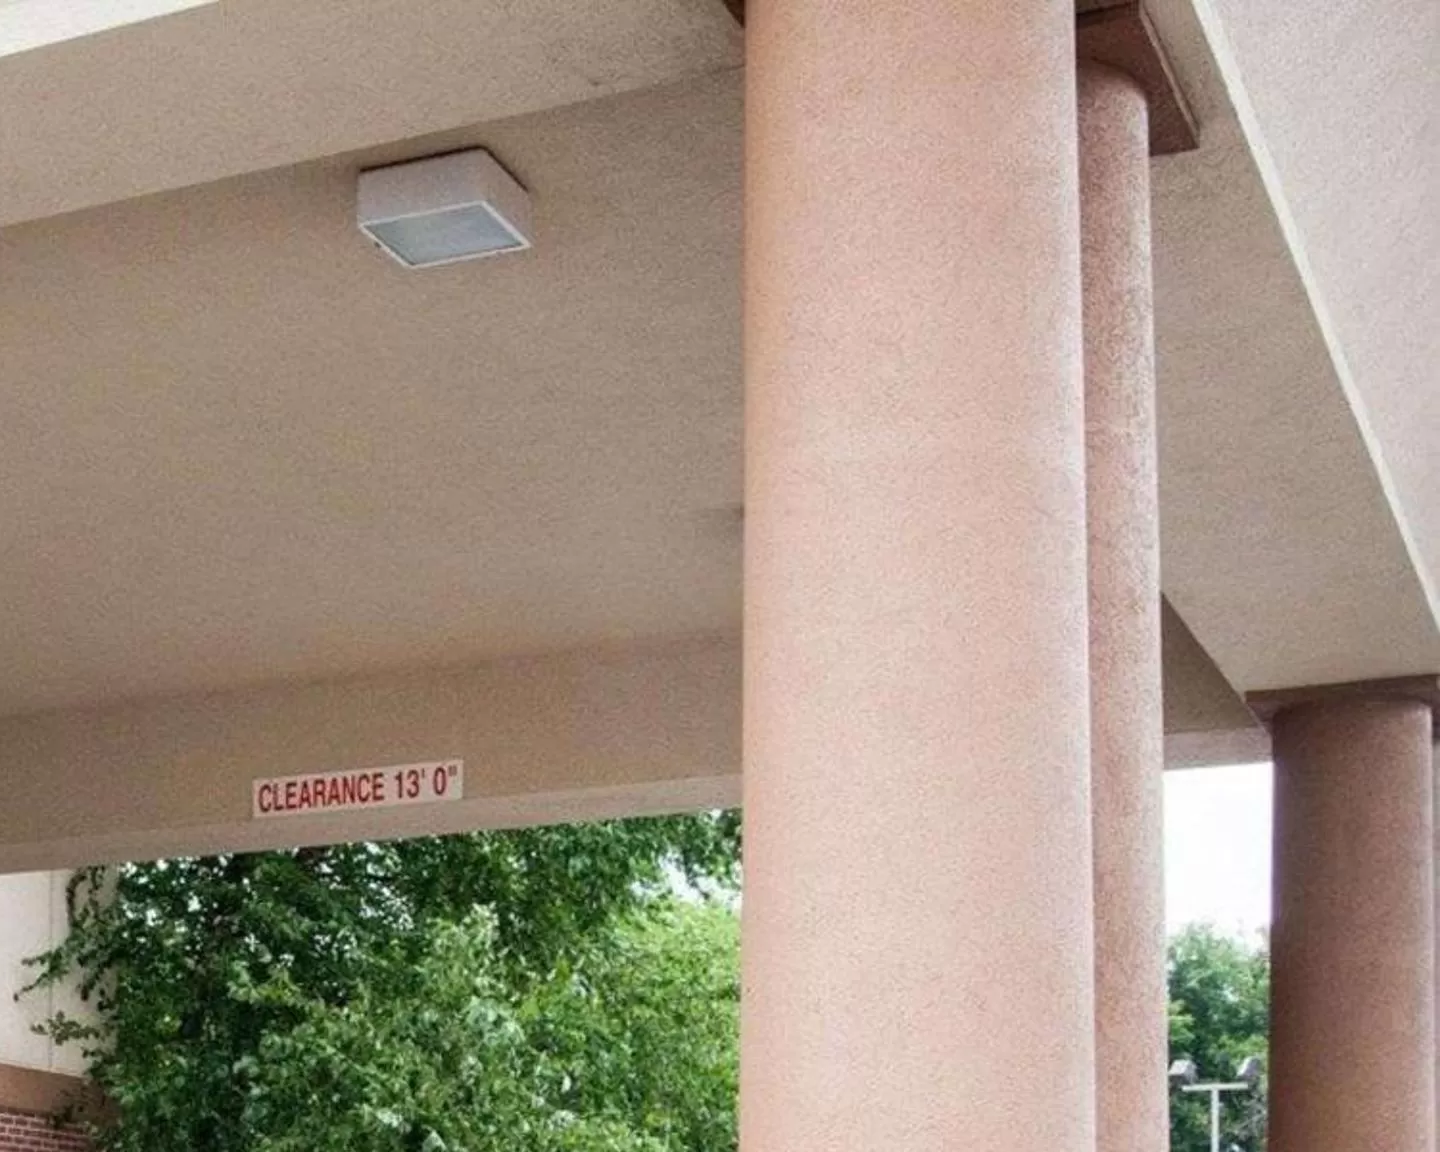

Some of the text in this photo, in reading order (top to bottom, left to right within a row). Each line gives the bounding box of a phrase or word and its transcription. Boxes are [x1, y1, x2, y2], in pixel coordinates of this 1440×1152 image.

[259, 765, 458, 813] CLEARANCE 13' 0"
